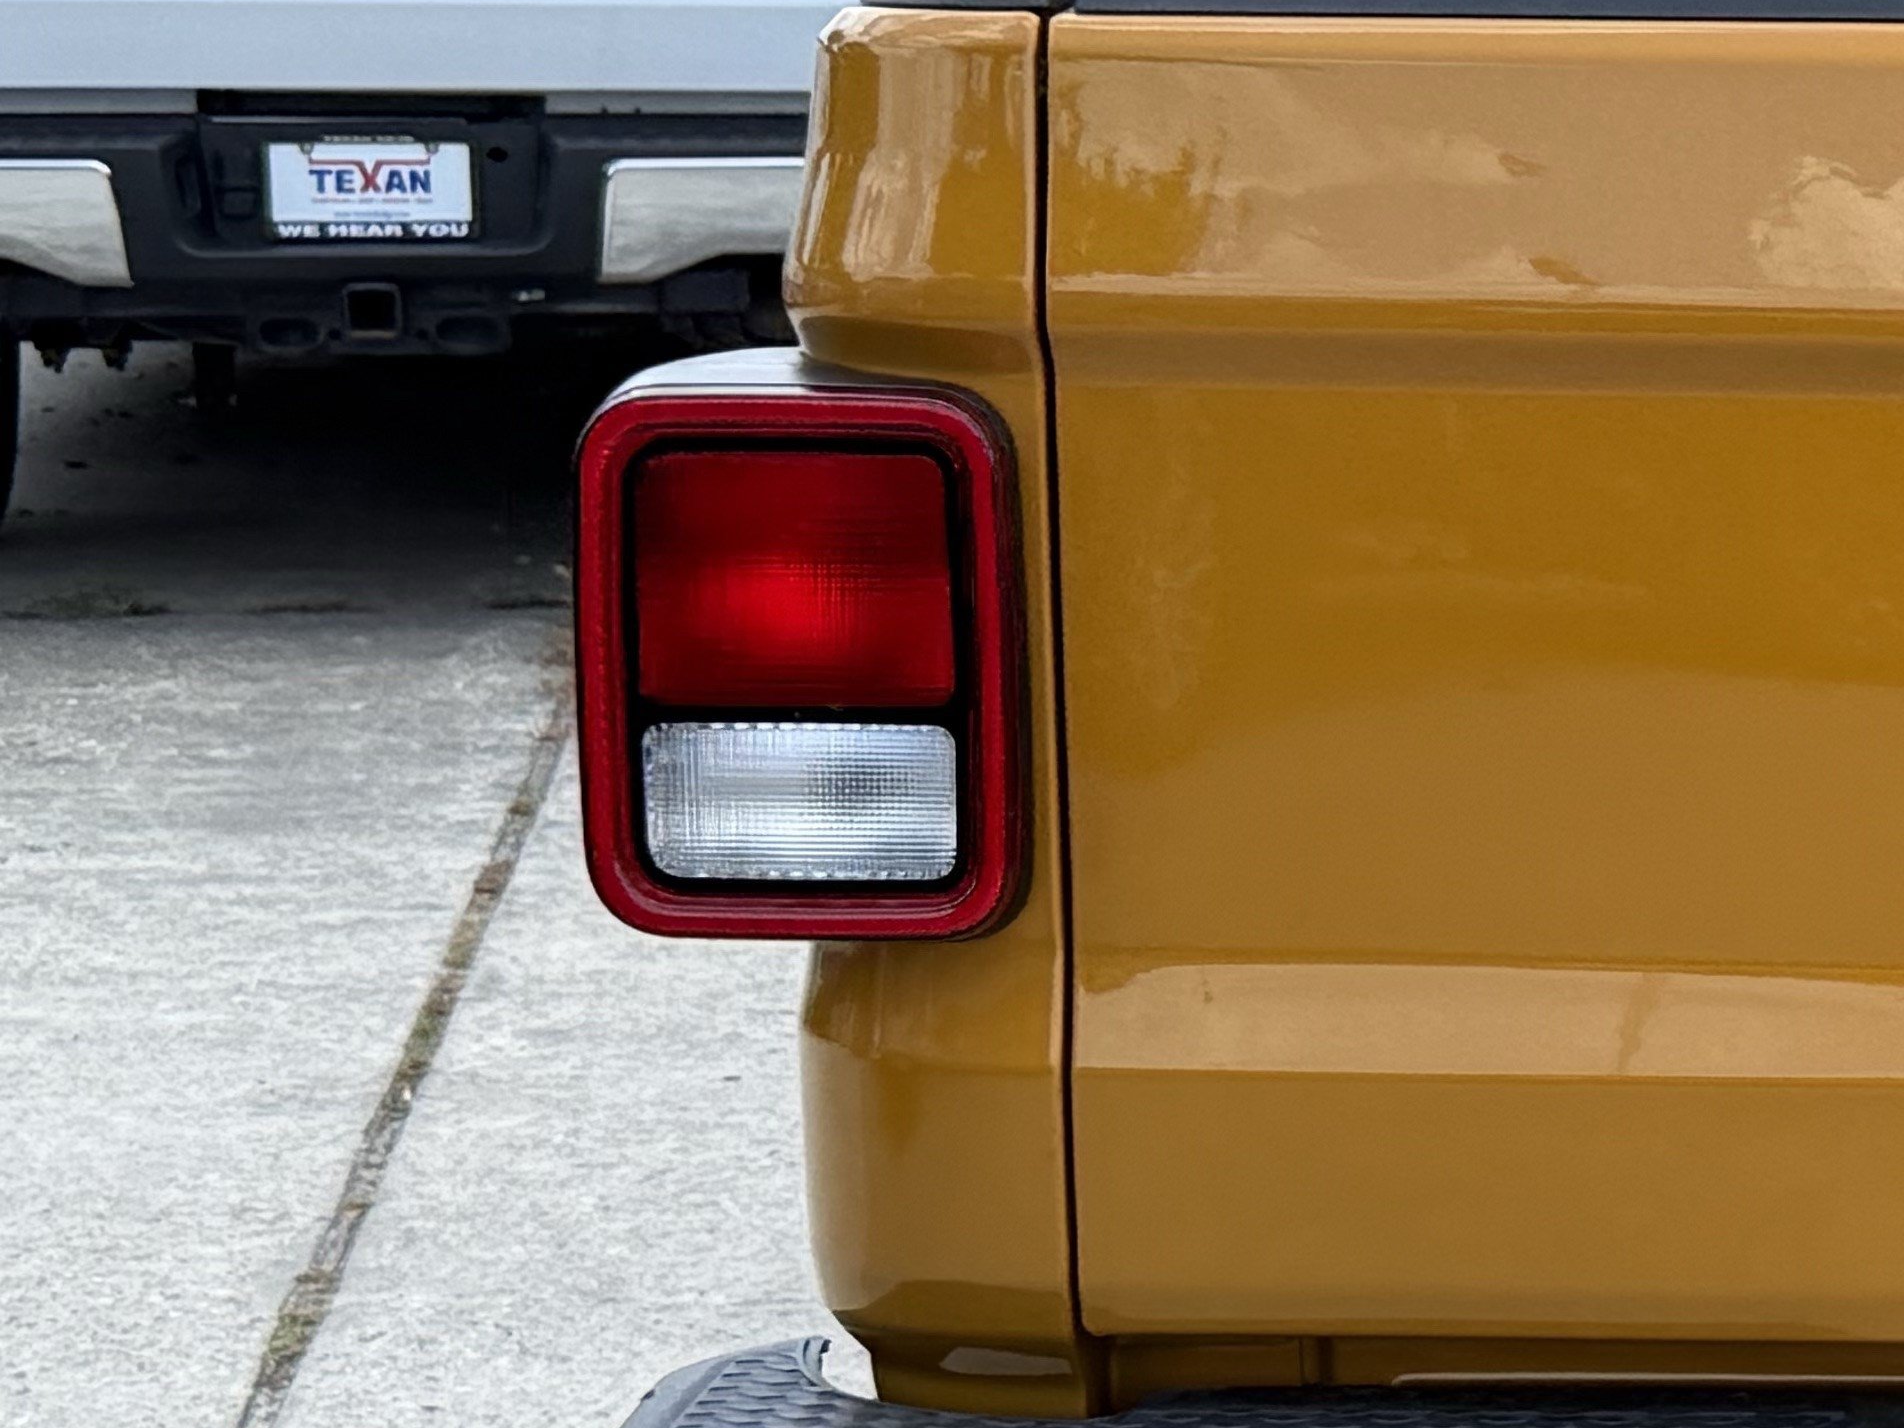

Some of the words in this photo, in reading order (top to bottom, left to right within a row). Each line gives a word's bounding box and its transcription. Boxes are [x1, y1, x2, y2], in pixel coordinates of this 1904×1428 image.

[308, 160, 433, 194] TEXAN
[277, 223, 321, 239] WE
[327, 223, 404, 239] HEAR
[411, 223, 470, 239] YOU
